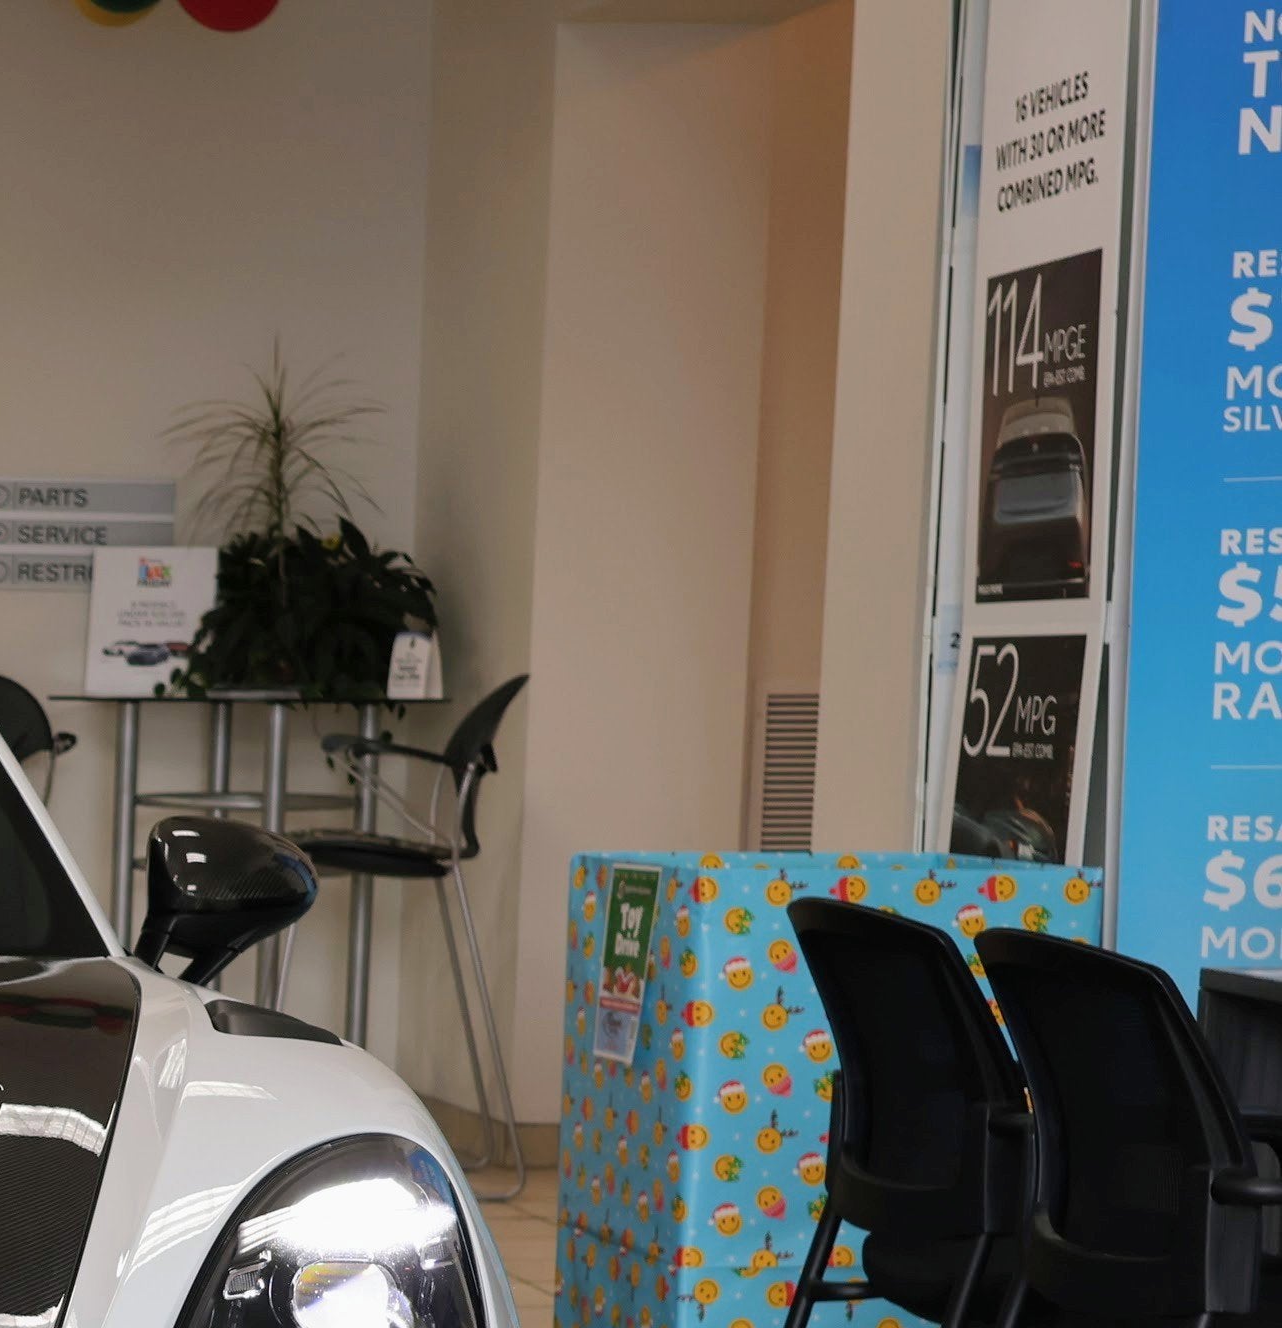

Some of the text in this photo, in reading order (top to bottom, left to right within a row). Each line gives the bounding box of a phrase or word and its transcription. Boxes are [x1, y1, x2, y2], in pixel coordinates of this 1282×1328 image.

[1244, 8, 1282, 43] N
[1030, 70, 1089, 118] VEHICLES
[996, 136, 1028, 172] WITH
[1046, 124, 1065, 154] OR
[1067, 108, 1106, 148] MORE
[997, 168, 1063, 213] COMBINED
[1232, 249, 1282, 279] RE
[988, 273, 1087, 397] 114 MPGE
[18, 487, 89, 508] PARTS
[17, 525, 108, 546] SERVICE
[17, 562, 92, 583] RESTR
[963, 643, 1058, 757] 52 MPG
[1207, 815, 1282, 842] RES
[619, 902, 645, 938] Toy
[1200, 926, 1282, 960] MO
